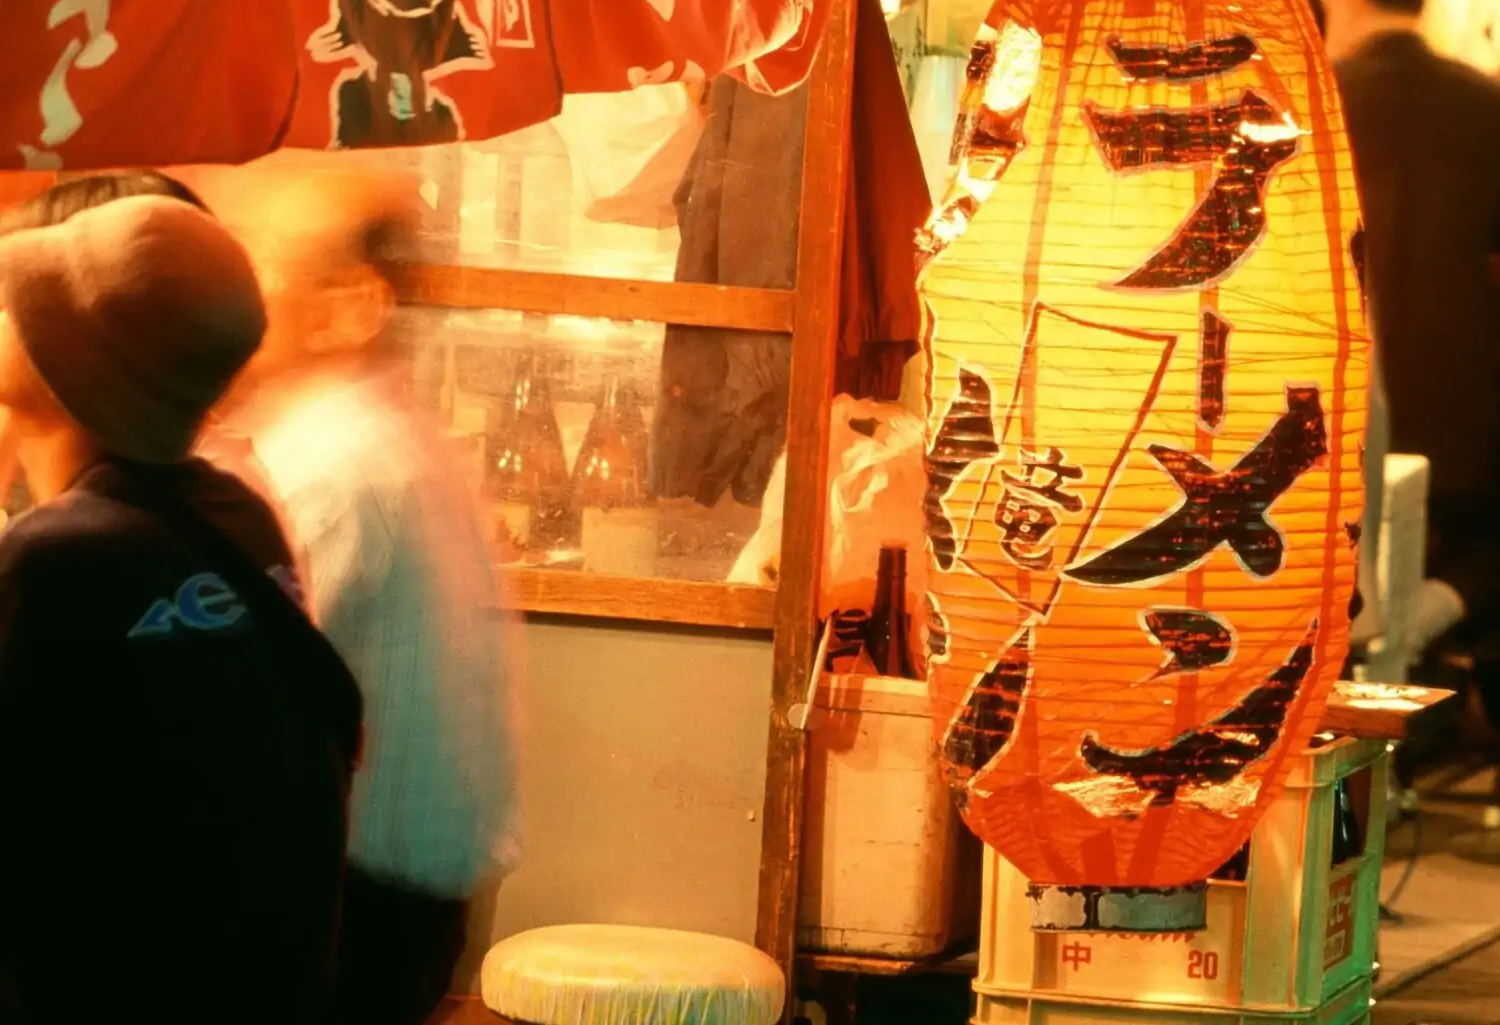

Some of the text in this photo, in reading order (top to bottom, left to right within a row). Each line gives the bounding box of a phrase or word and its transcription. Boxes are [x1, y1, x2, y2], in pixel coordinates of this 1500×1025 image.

[1060, 31, 1329, 809] ラーメン
[1062, 940, 1218, 980] 中 20
